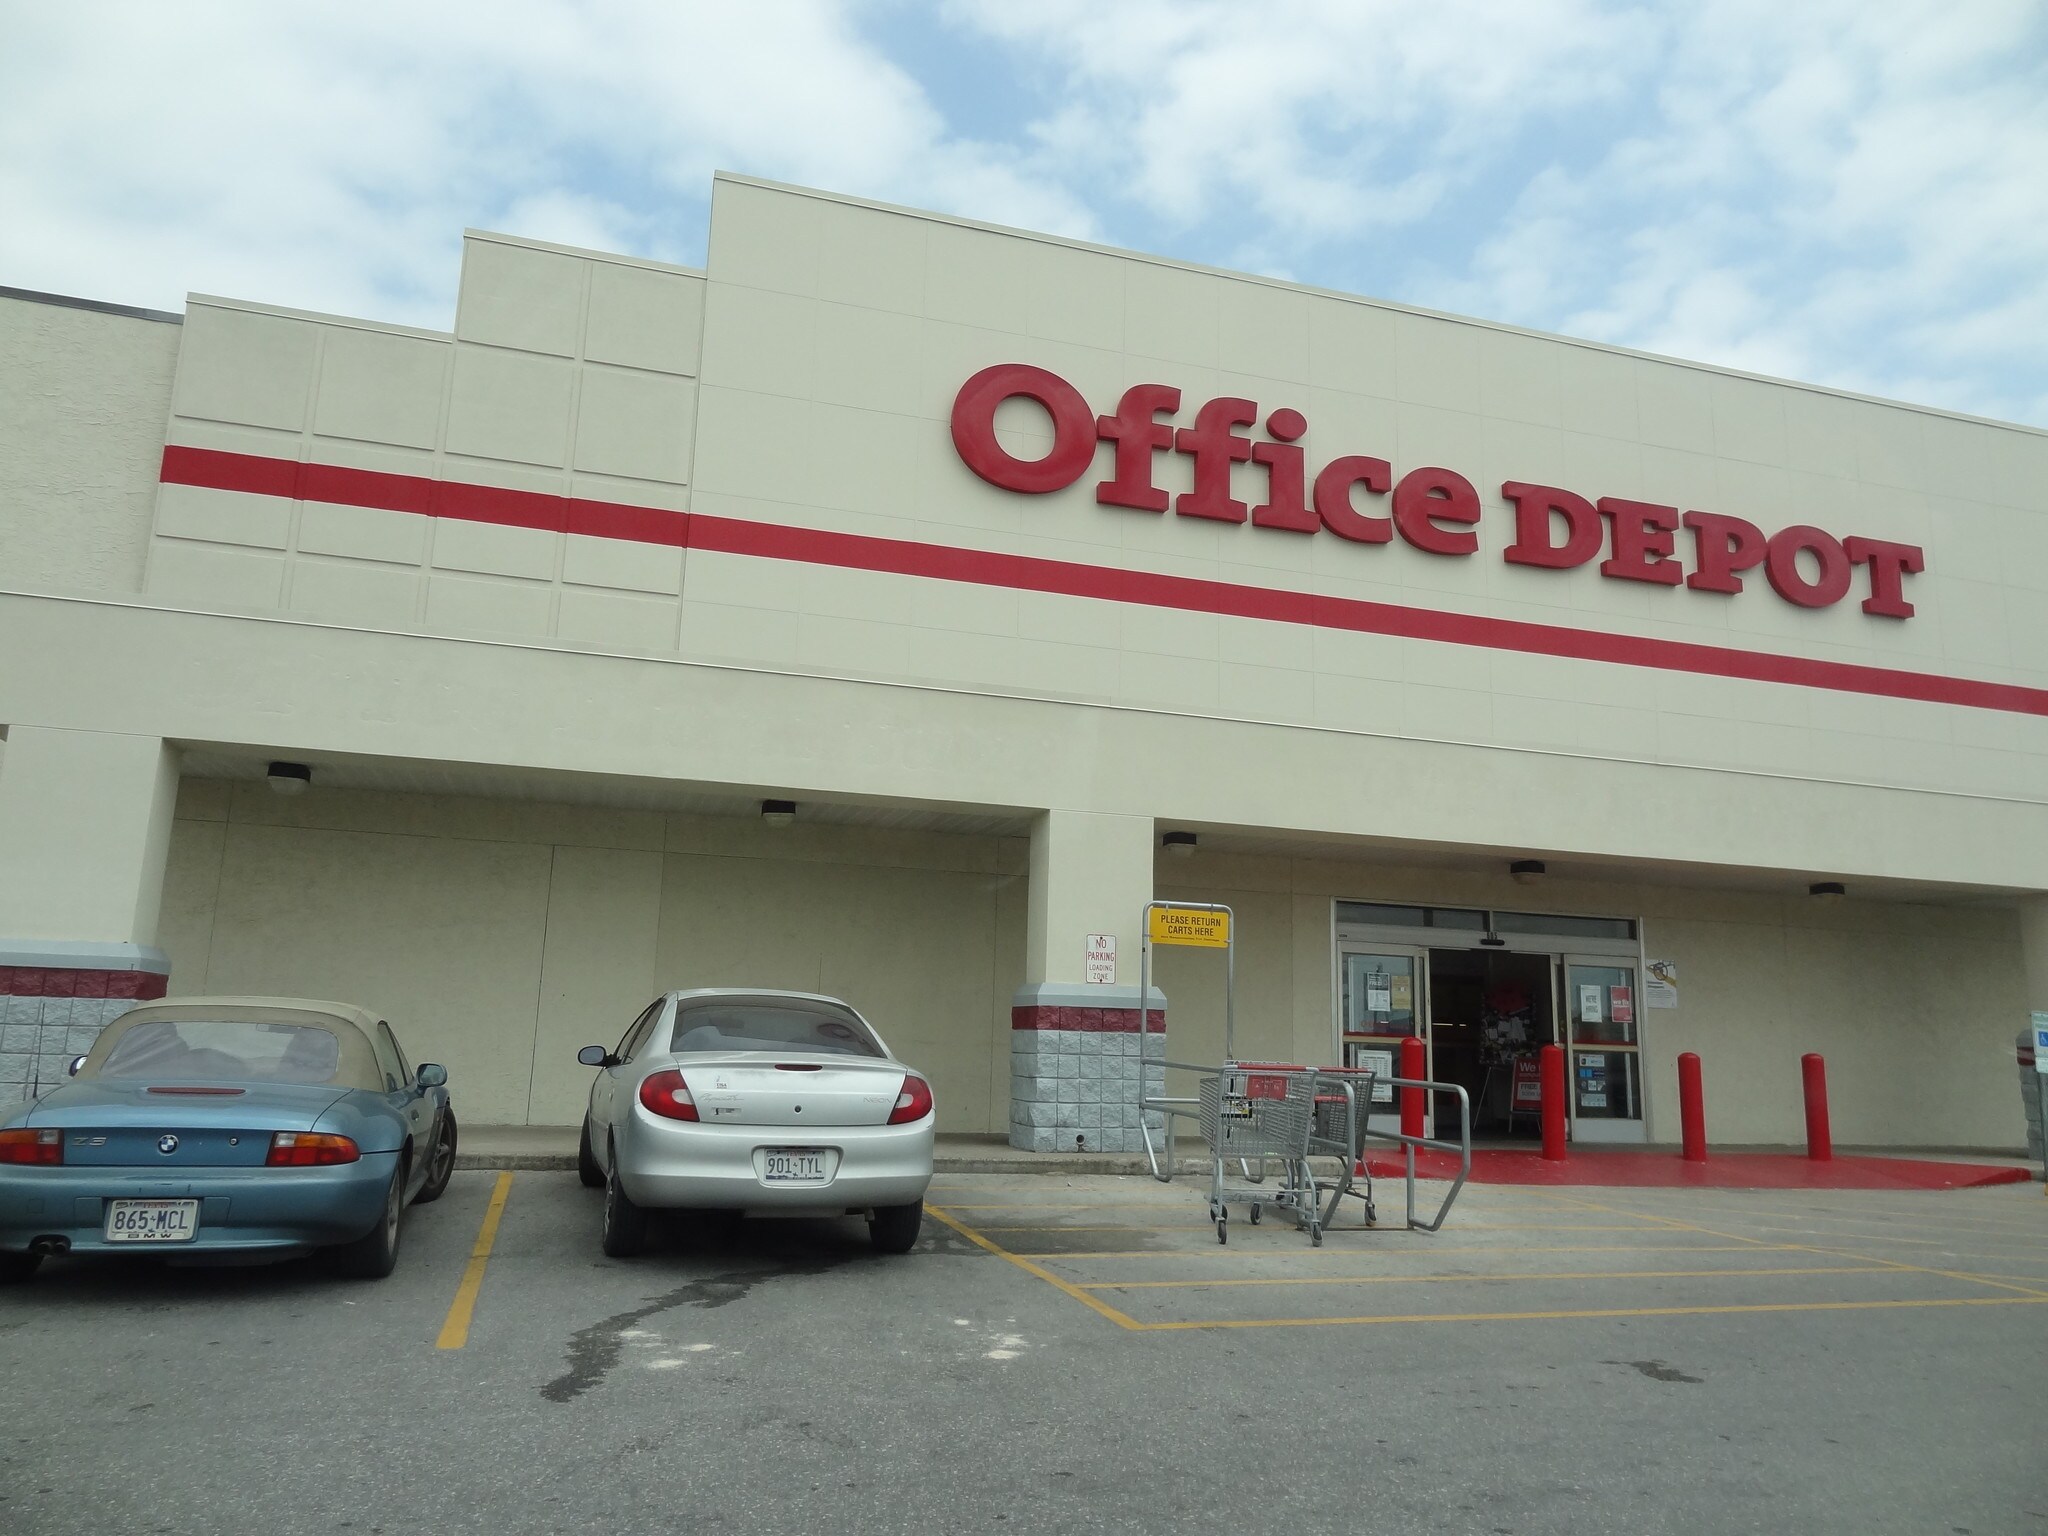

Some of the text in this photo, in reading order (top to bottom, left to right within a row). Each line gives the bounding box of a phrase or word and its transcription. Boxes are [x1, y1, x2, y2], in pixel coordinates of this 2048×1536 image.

[952, 363, 1924, 619] Office DEPOT
[1161, 914, 1221, 927] PLEASE RETURN
[1168, 925, 1214, 936] CARTS HERE
[1096, 939, 1107, 949] NO
[1087, 951, 1115, 962] PARKING
[1089, 964, 1113, 972] LOADING
[1093, 972, 1109, 980] ZONE
[1520, 1062, 1536, 1072] We
